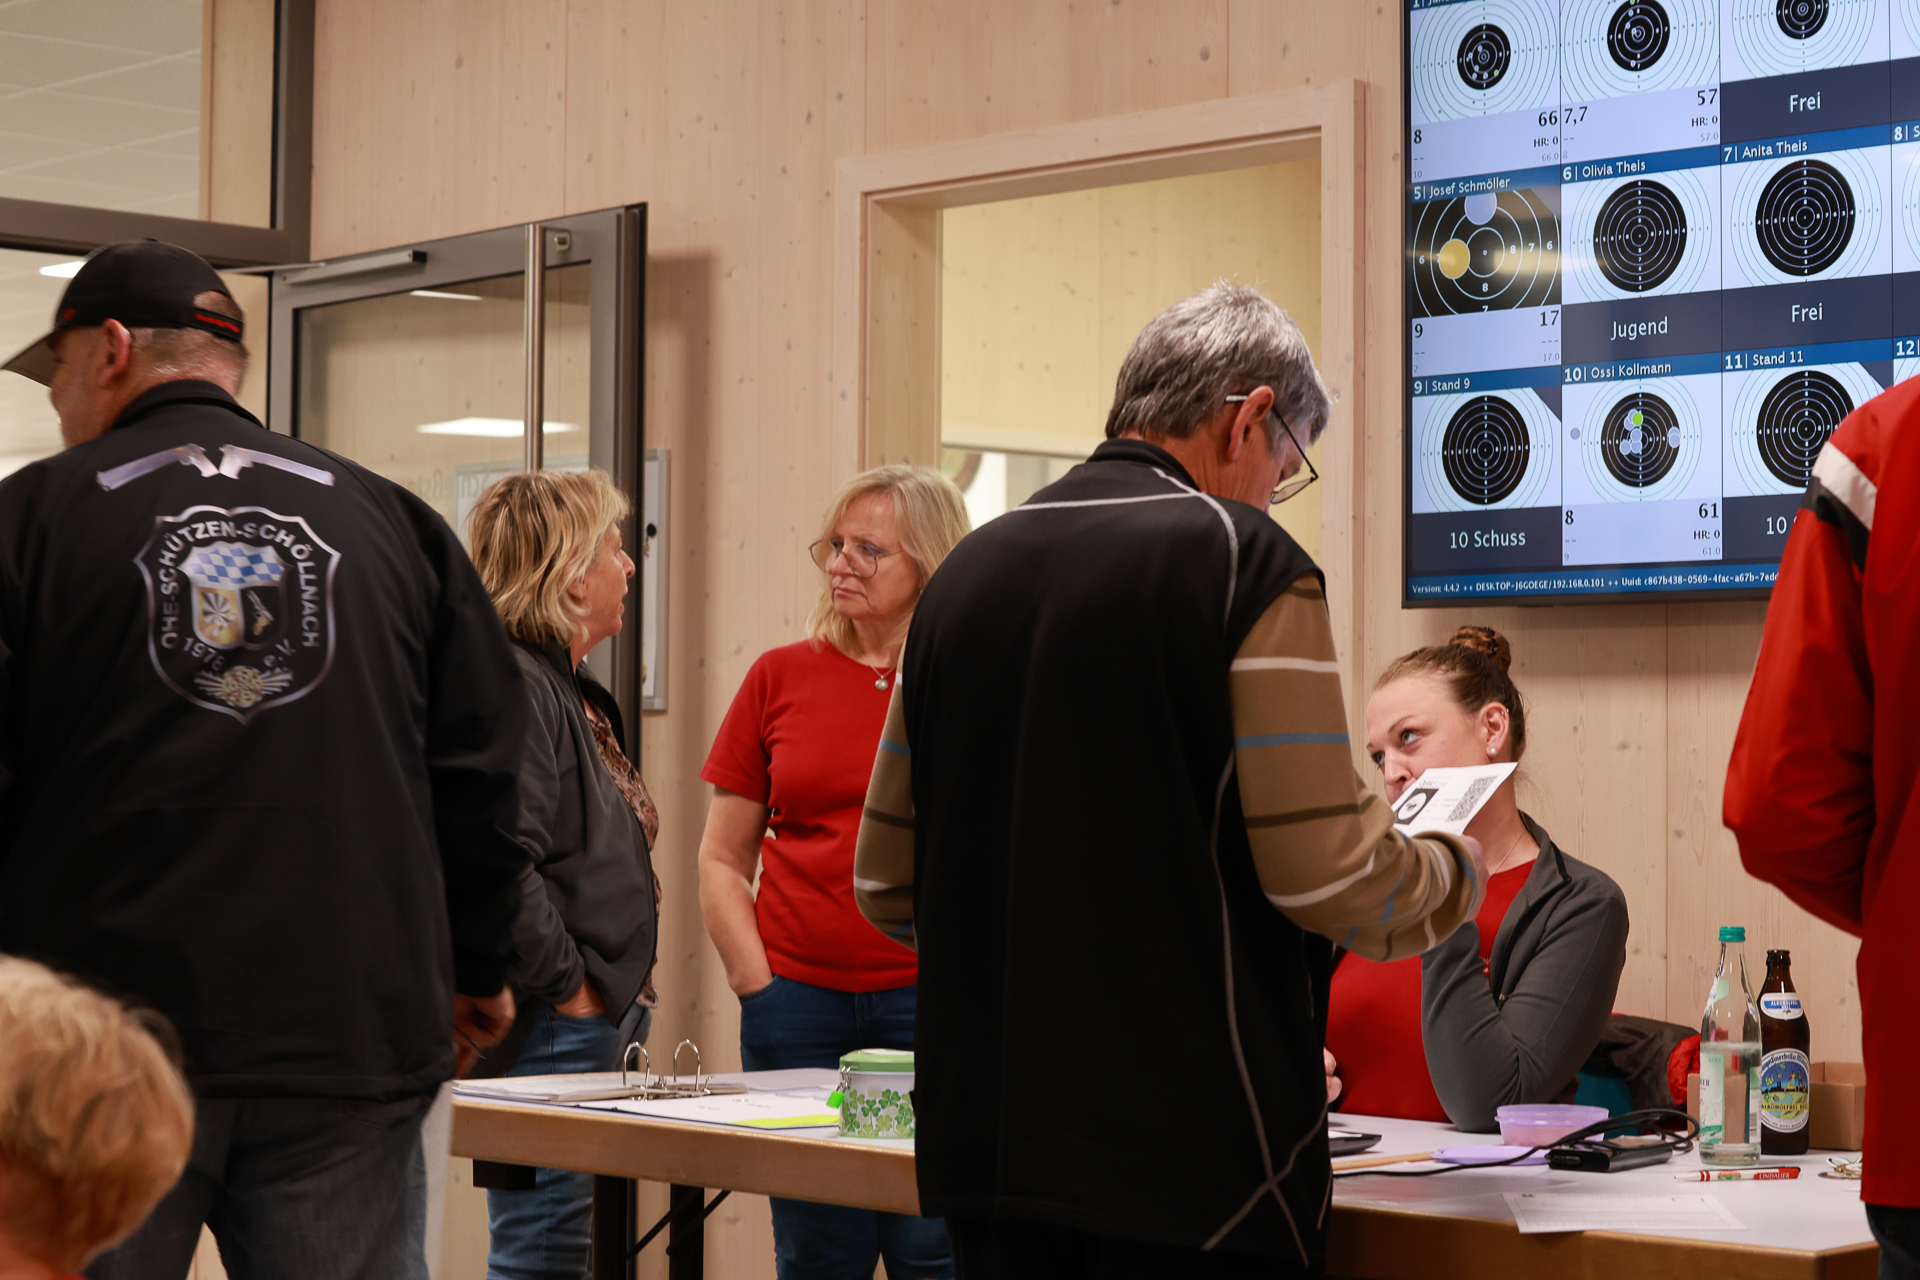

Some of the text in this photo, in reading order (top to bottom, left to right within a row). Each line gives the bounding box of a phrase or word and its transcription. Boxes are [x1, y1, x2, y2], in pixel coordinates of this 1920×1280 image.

[1697, 88, 1718, 106] 57
[1789, 91, 1821, 113] Frei
[1538, 109, 1558, 127] 66
[1564, 106, 1588, 126] 7,7
[1691, 115, 1718, 127] HR: 0
[1413, 129, 1422, 144] 8
[1533, 136, 1559, 148] HR: 0
[1700, 132, 1719, 142] 57.0
[1541, 152, 1559, 162] 66.0
[1562, 151, 1568, 160] 8
[1742, 144, 1773, 159] Anita
[1776, 139, 1808, 154] Theis
[1413, 170, 1423, 179] 10
[1582, 161, 1613, 178] Olivia
[1616, 159, 1646, 173] Theis
[1429, 182, 1456, 199] Josef
[1458, 177, 1511, 194] Schmöller
[1419, 240, 1553, 265] 6 8 7 6
[1482, 282, 1489, 293] 8
[1540, 309, 1560, 327] 17
[1791, 302, 1824, 323] Frei
[1414, 323, 1423, 339] 9
[1610, 315, 1669, 341] Jugend
[1543, 352, 1560, 362] 17.0
[1752, 351, 1786, 366] Stand
[1790, 350, 1804, 364] 11
[1591, 364, 1616, 378] Ossi
[1618, 361, 1673, 377] Kollmann
[1431, 378, 1461, 392] Stand
[1463, 377, 1471, 390] 9
[1565, 510, 1574, 525] 8
[1698, 502, 1719, 519] 61
[1766, 516, 1788, 535] 10
[1450, 529, 1526, 549] 10 Schuss
[1693, 528, 1720, 540] HR: 0
[1702, 546, 1721, 556] 61.0
[1412, 584, 1442, 594] Version:
[1443, 584, 1460, 593] 4.4.2
[1758, 1172, 1791, 1180] LINDAUER
